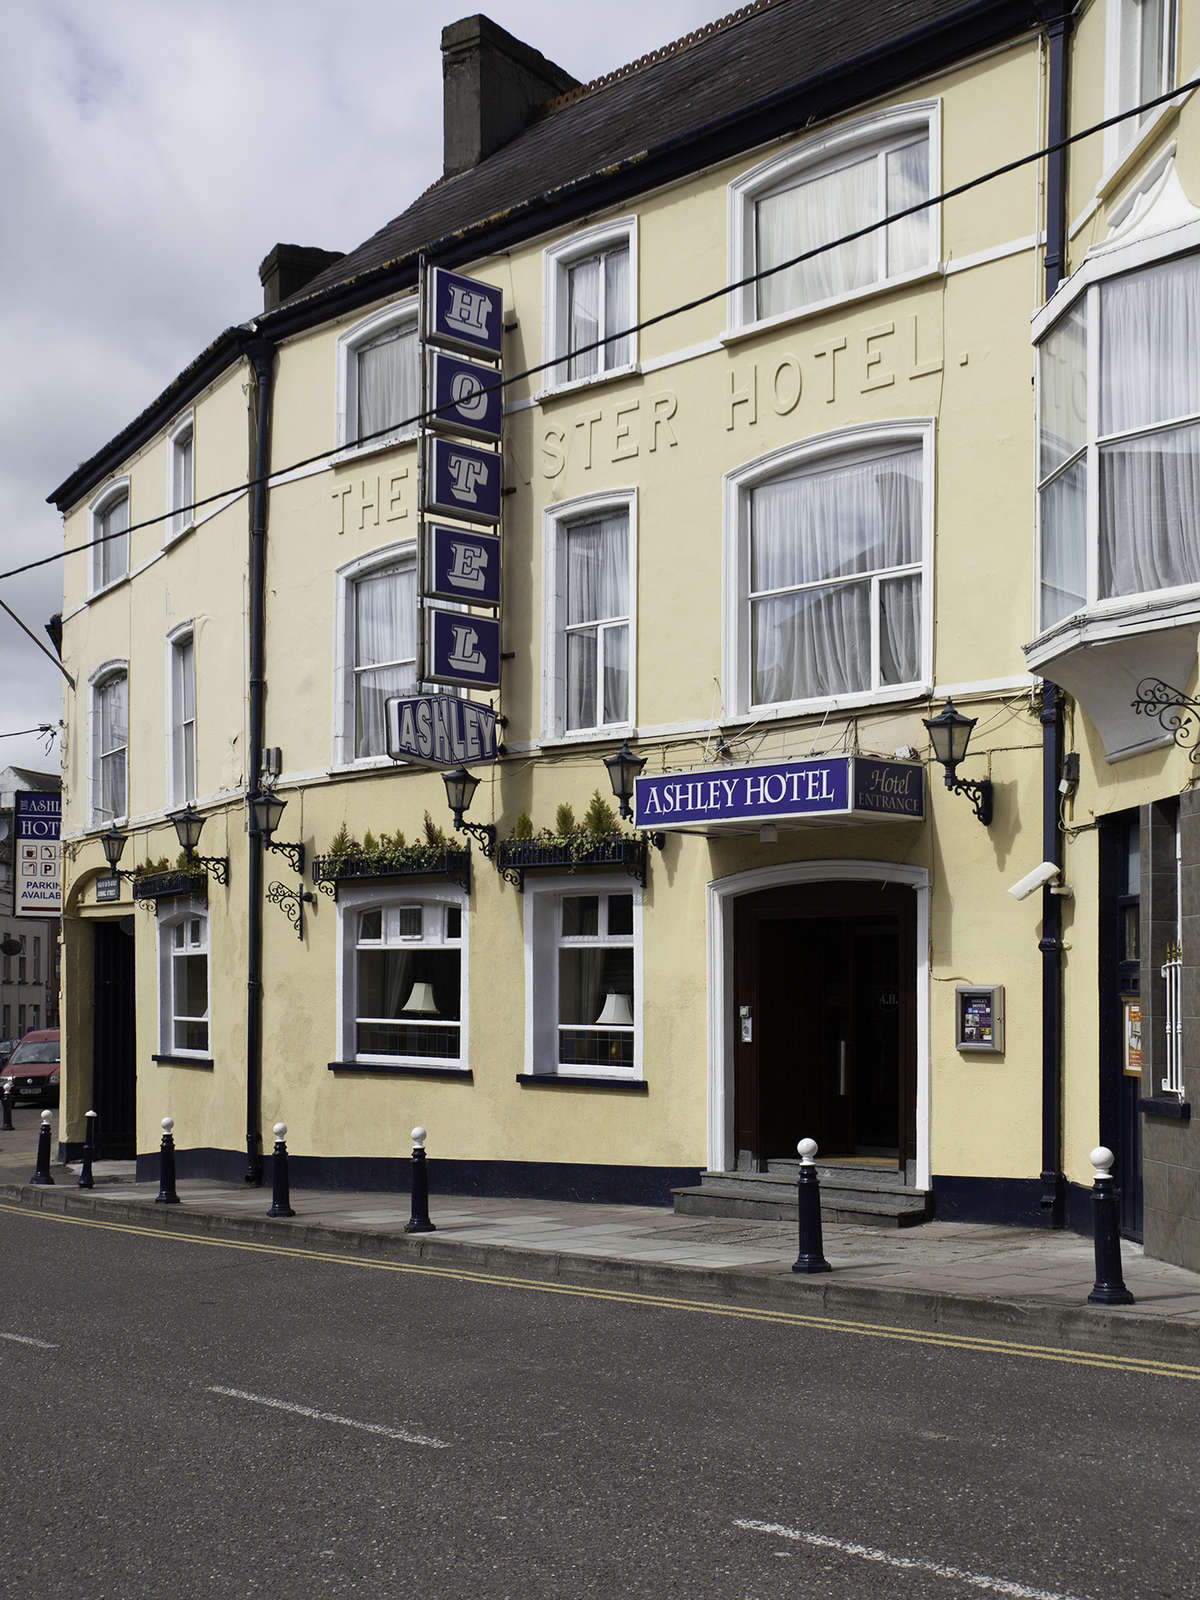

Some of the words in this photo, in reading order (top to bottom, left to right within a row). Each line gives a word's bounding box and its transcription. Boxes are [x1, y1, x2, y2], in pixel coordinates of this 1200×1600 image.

[331, 468, 408, 535] THE
[444, 283, 495, 674] HOTEL
[397, 698, 497, 763] ASHLEY
[644, 779, 738, 815] ASHLEY
[744, 769, 835, 805] HOTEL
[858, 794, 920, 812] ENTRANCE
[869, 767, 913, 796] Hotel
[21, 820, 61, 837] HOT
